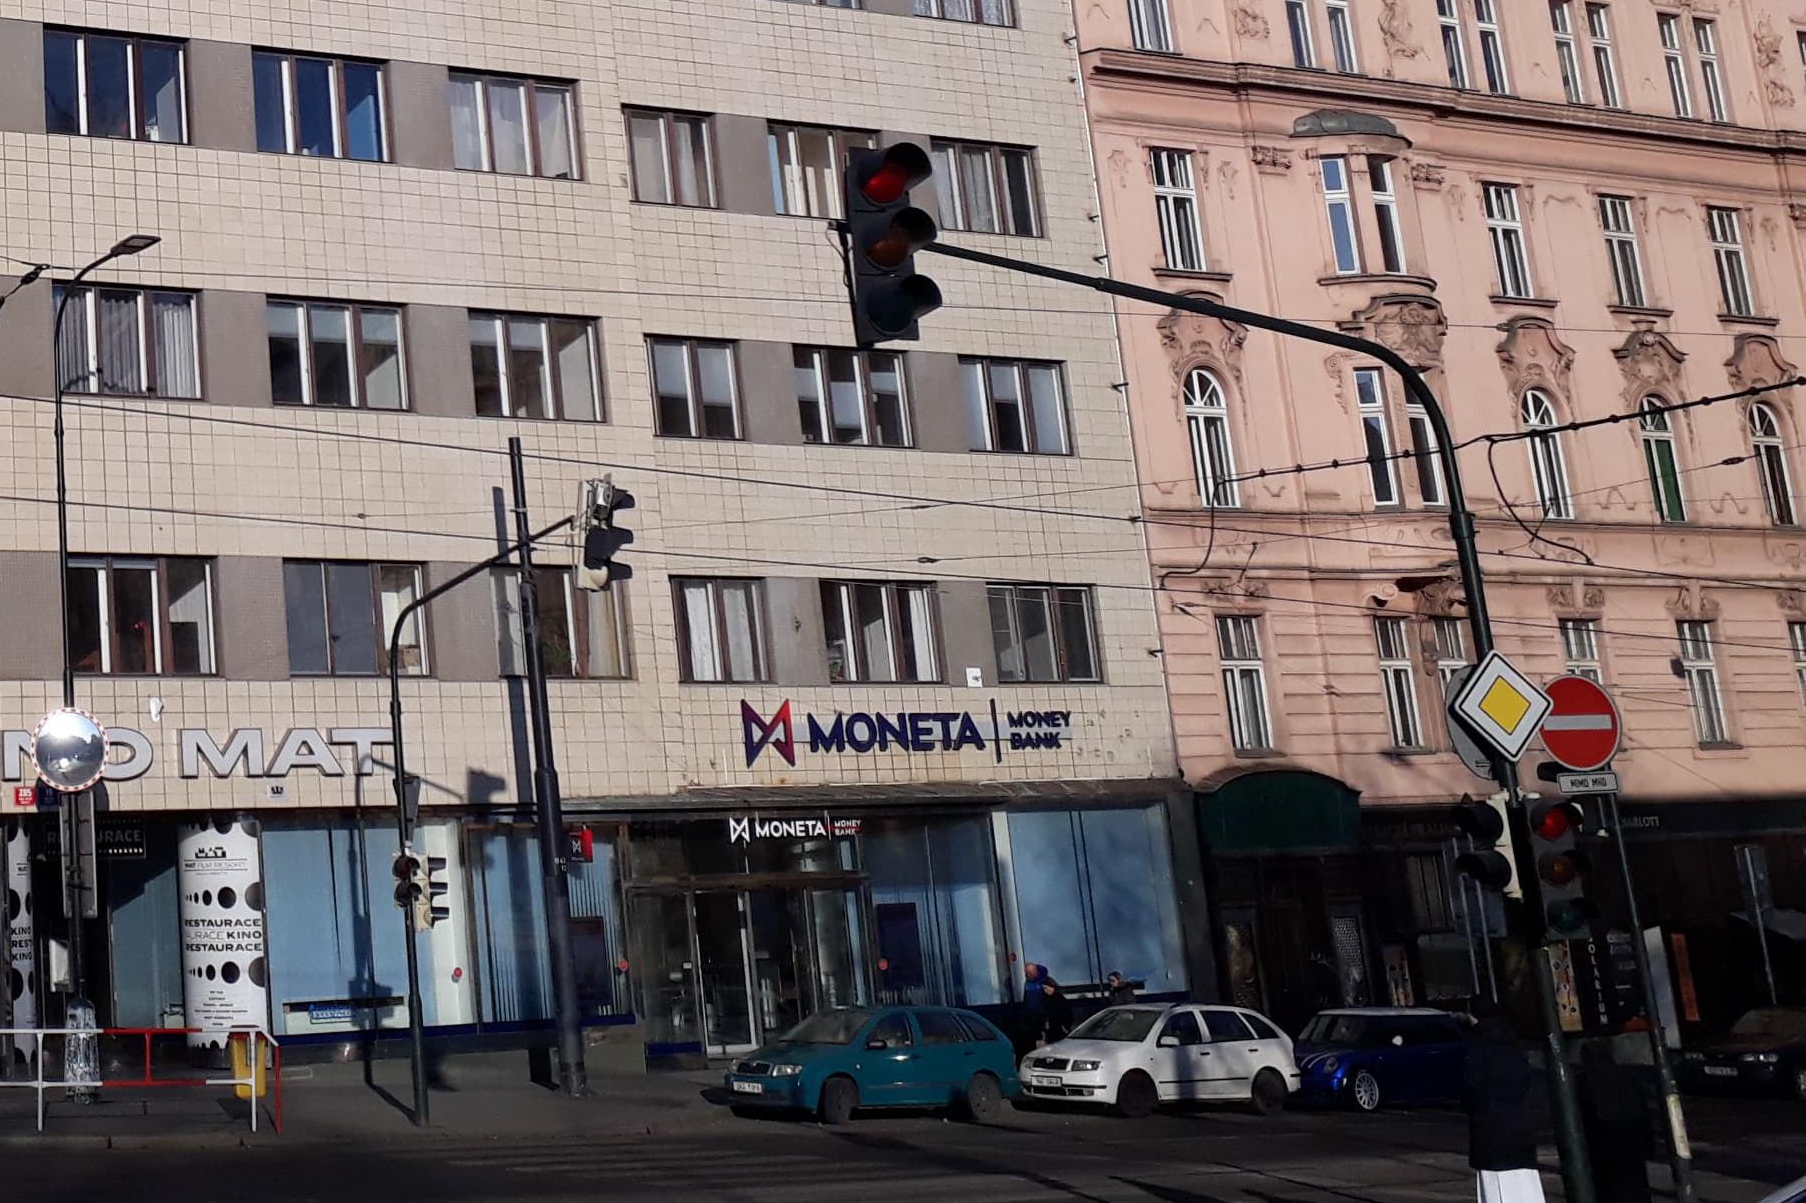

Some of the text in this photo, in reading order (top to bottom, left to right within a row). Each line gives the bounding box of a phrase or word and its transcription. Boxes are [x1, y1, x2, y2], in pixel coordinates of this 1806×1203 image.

[1007, 710, 1072, 729] MONEY
[806, 710, 986, 754] MONETA
[1010, 732, 1063, 750] BANK
[178, 727, 395, 779] MAT
[754, 820, 827, 838] MONETA
[834, 819, 862, 828] MONEY
[46, 828, 143, 844] RURACE
[227, 930, 262, 939] KINO
